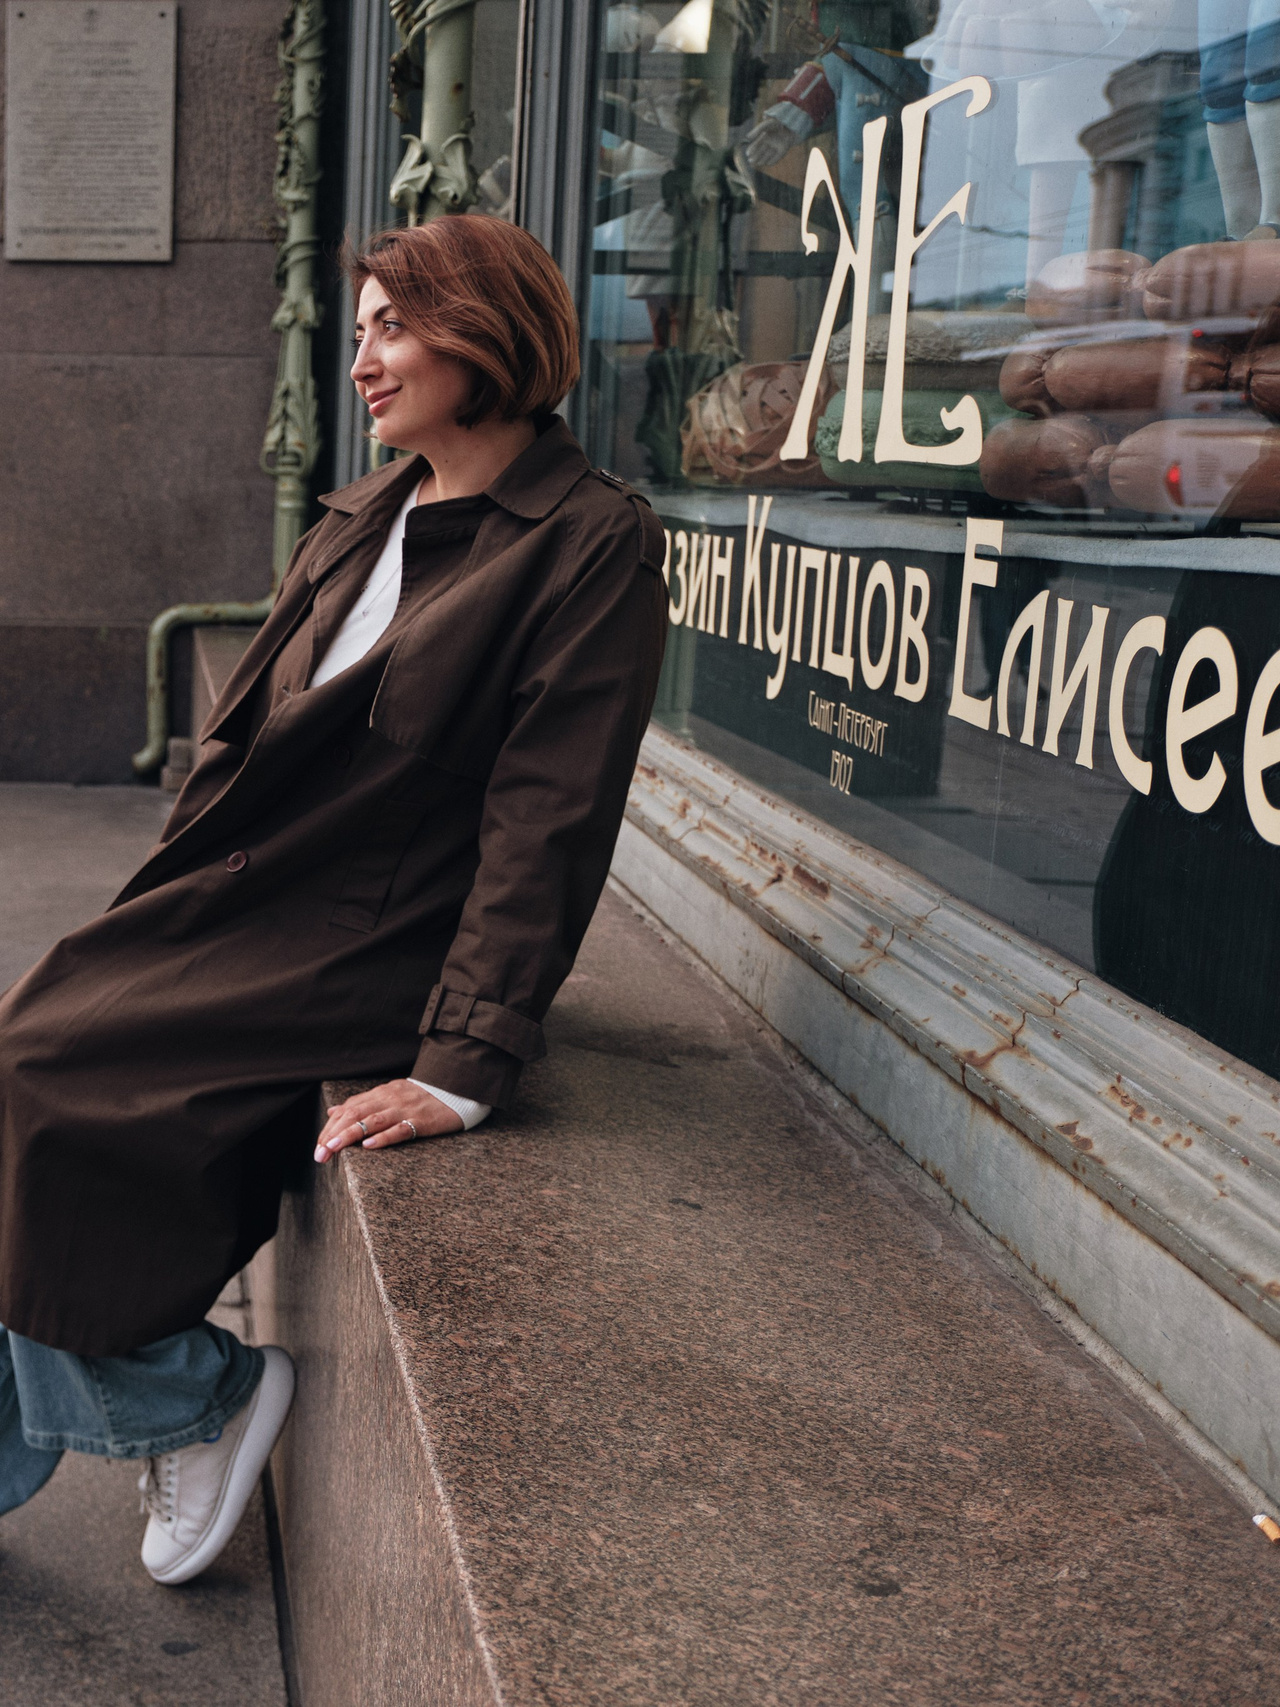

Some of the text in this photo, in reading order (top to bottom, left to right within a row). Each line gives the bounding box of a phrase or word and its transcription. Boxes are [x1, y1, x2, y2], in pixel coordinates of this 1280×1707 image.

[661, 528, 735, 639] зин
[737, 495, 930, 703] Купцов
[829, 749, 853, 796] 1902
